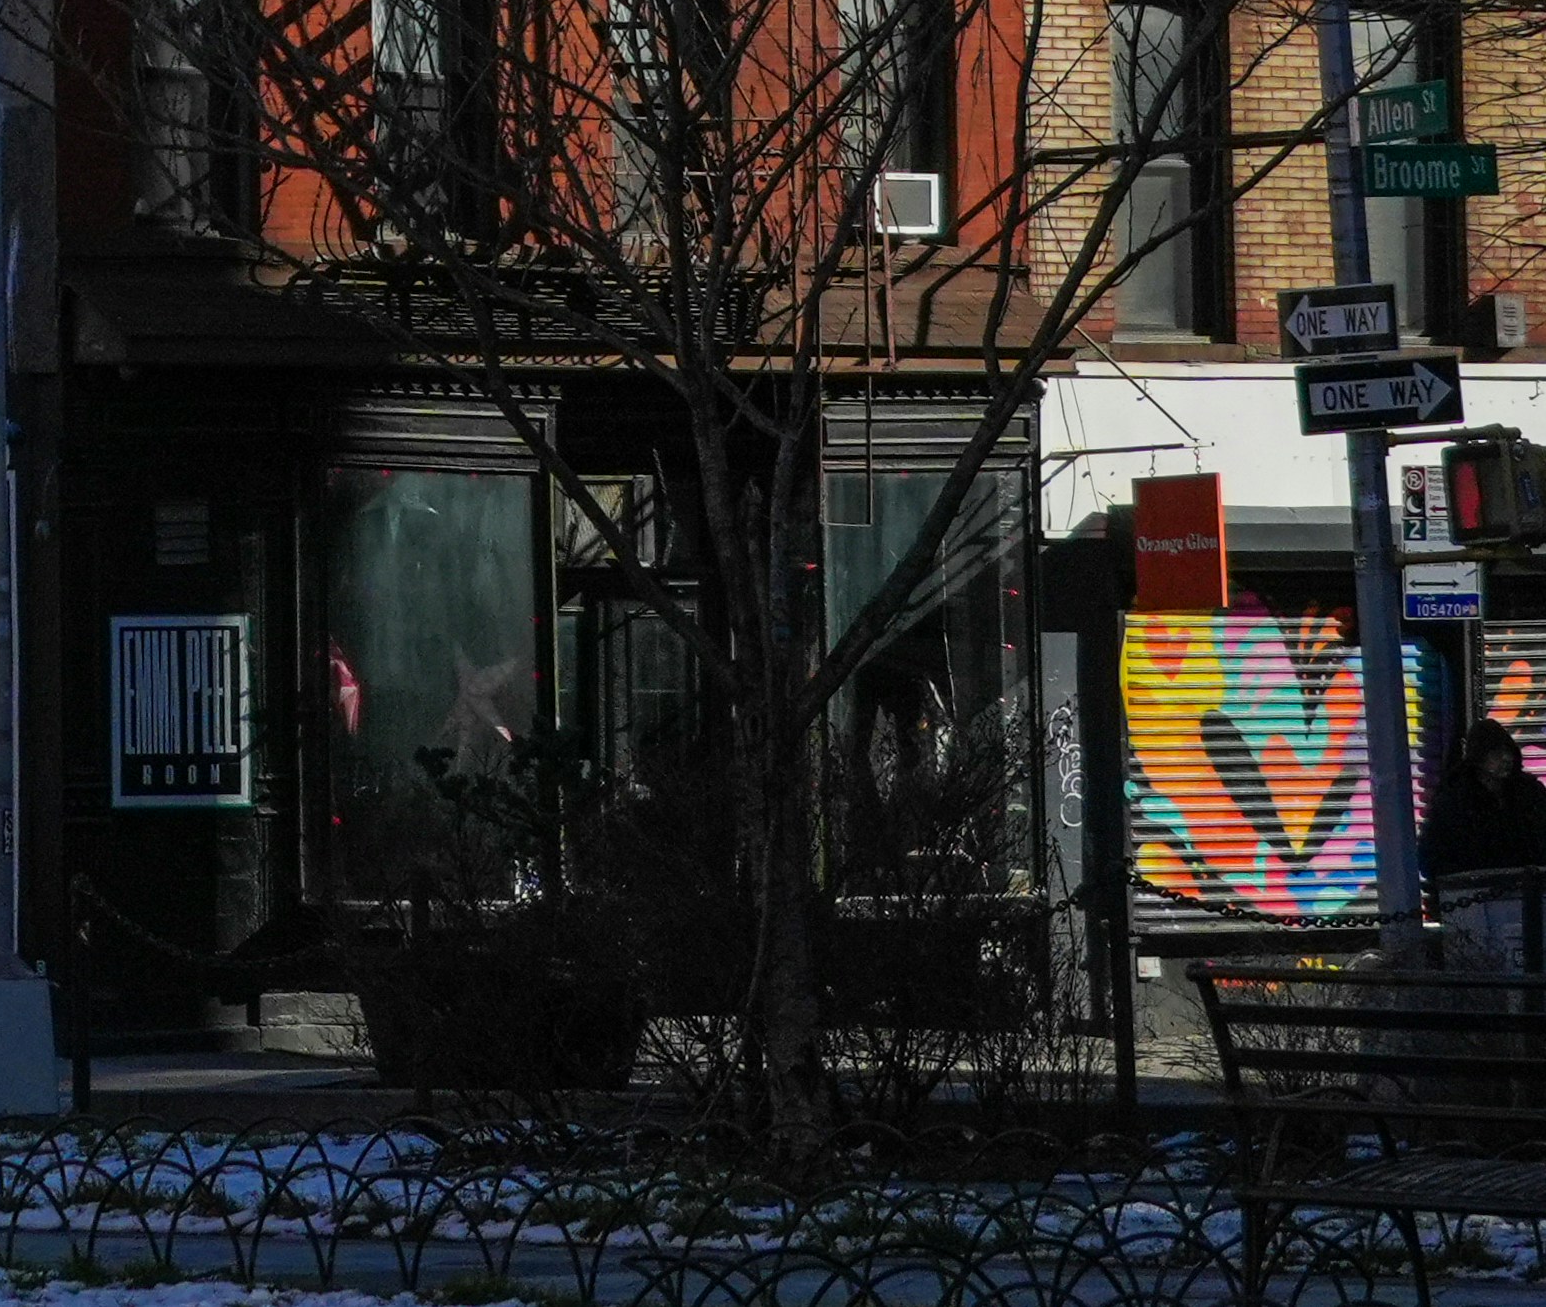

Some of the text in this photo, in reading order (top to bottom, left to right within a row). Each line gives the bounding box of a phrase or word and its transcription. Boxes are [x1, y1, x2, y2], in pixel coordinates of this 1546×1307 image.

[1367, 89, 1437, 136] Allen St
[1372, 151, 1487, 190] Broome St
[1296, 305, 1380, 336] ONE WAY
[1323, 379, 1436, 410] ONE WAY
[1136, 535, 1184, 554] Orange
[1408, 519, 1422, 539] 2
[123, 629, 238, 755] EMMA PEEL
[141, 762, 221, 786] ROOM
